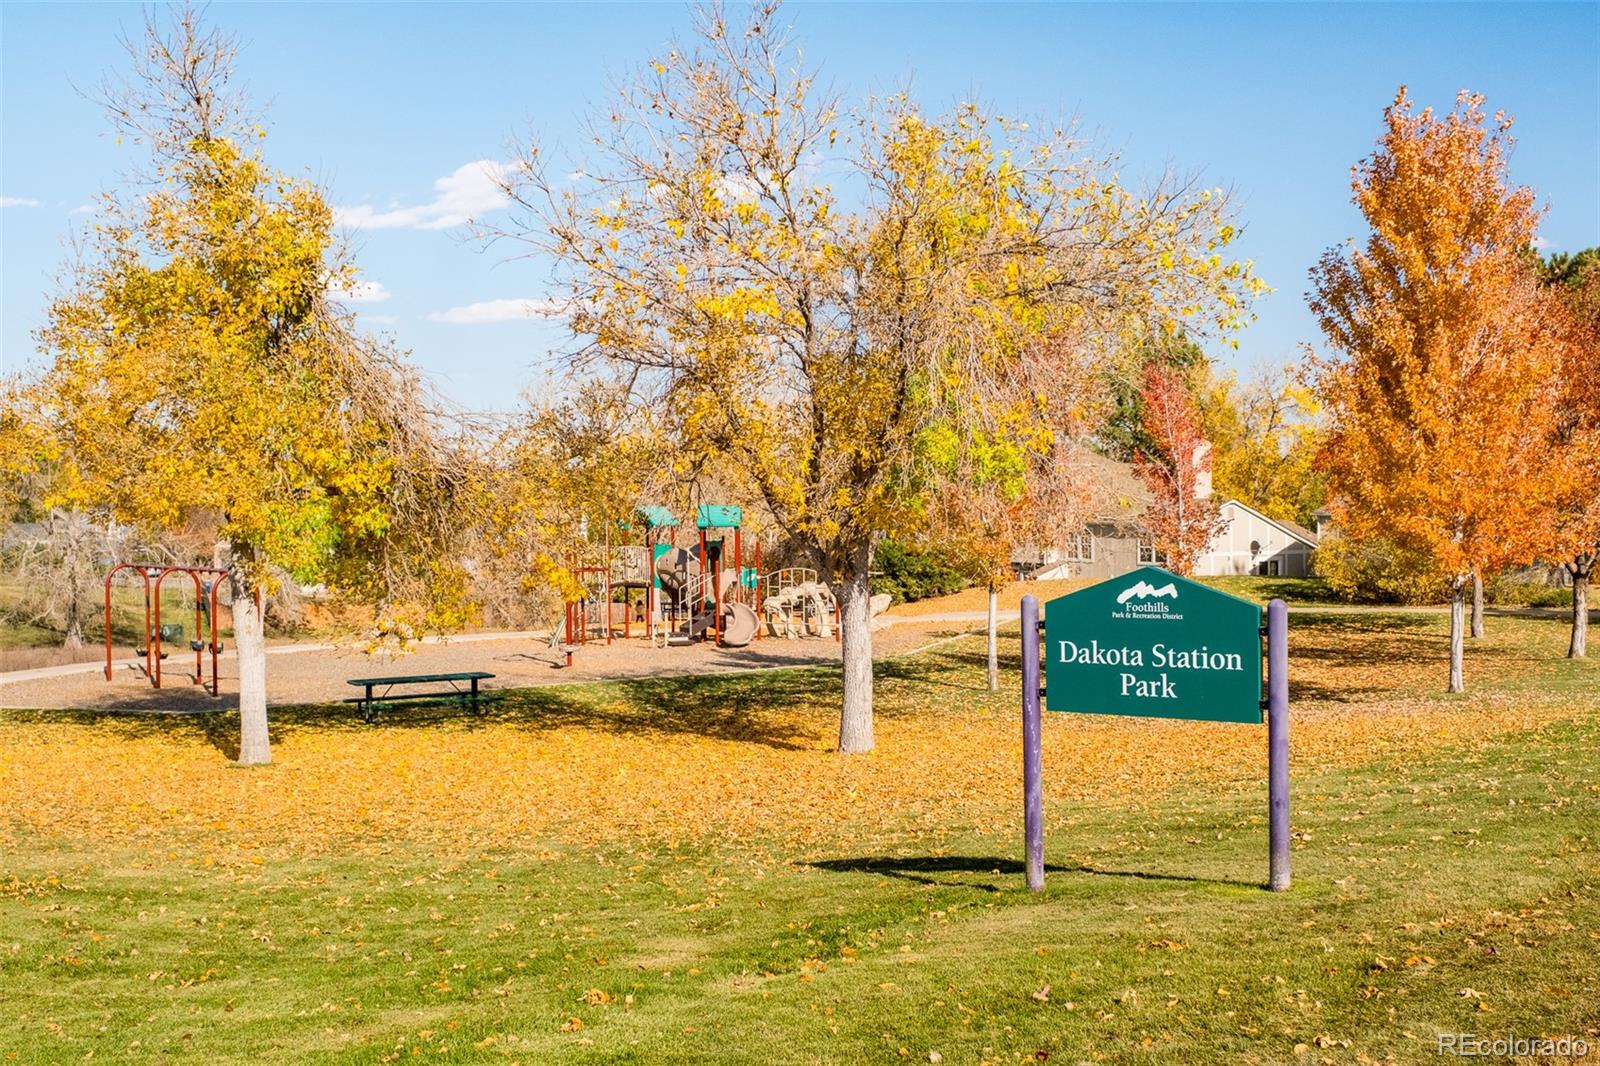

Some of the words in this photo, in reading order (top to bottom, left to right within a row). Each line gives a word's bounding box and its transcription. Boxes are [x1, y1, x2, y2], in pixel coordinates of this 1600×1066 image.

[1126, 602, 1169, 613] Foothills
[1058, 640, 1143, 666] Dakota
[1151, 643, 1243, 670] Station
[1120, 673, 1178, 698] Park
